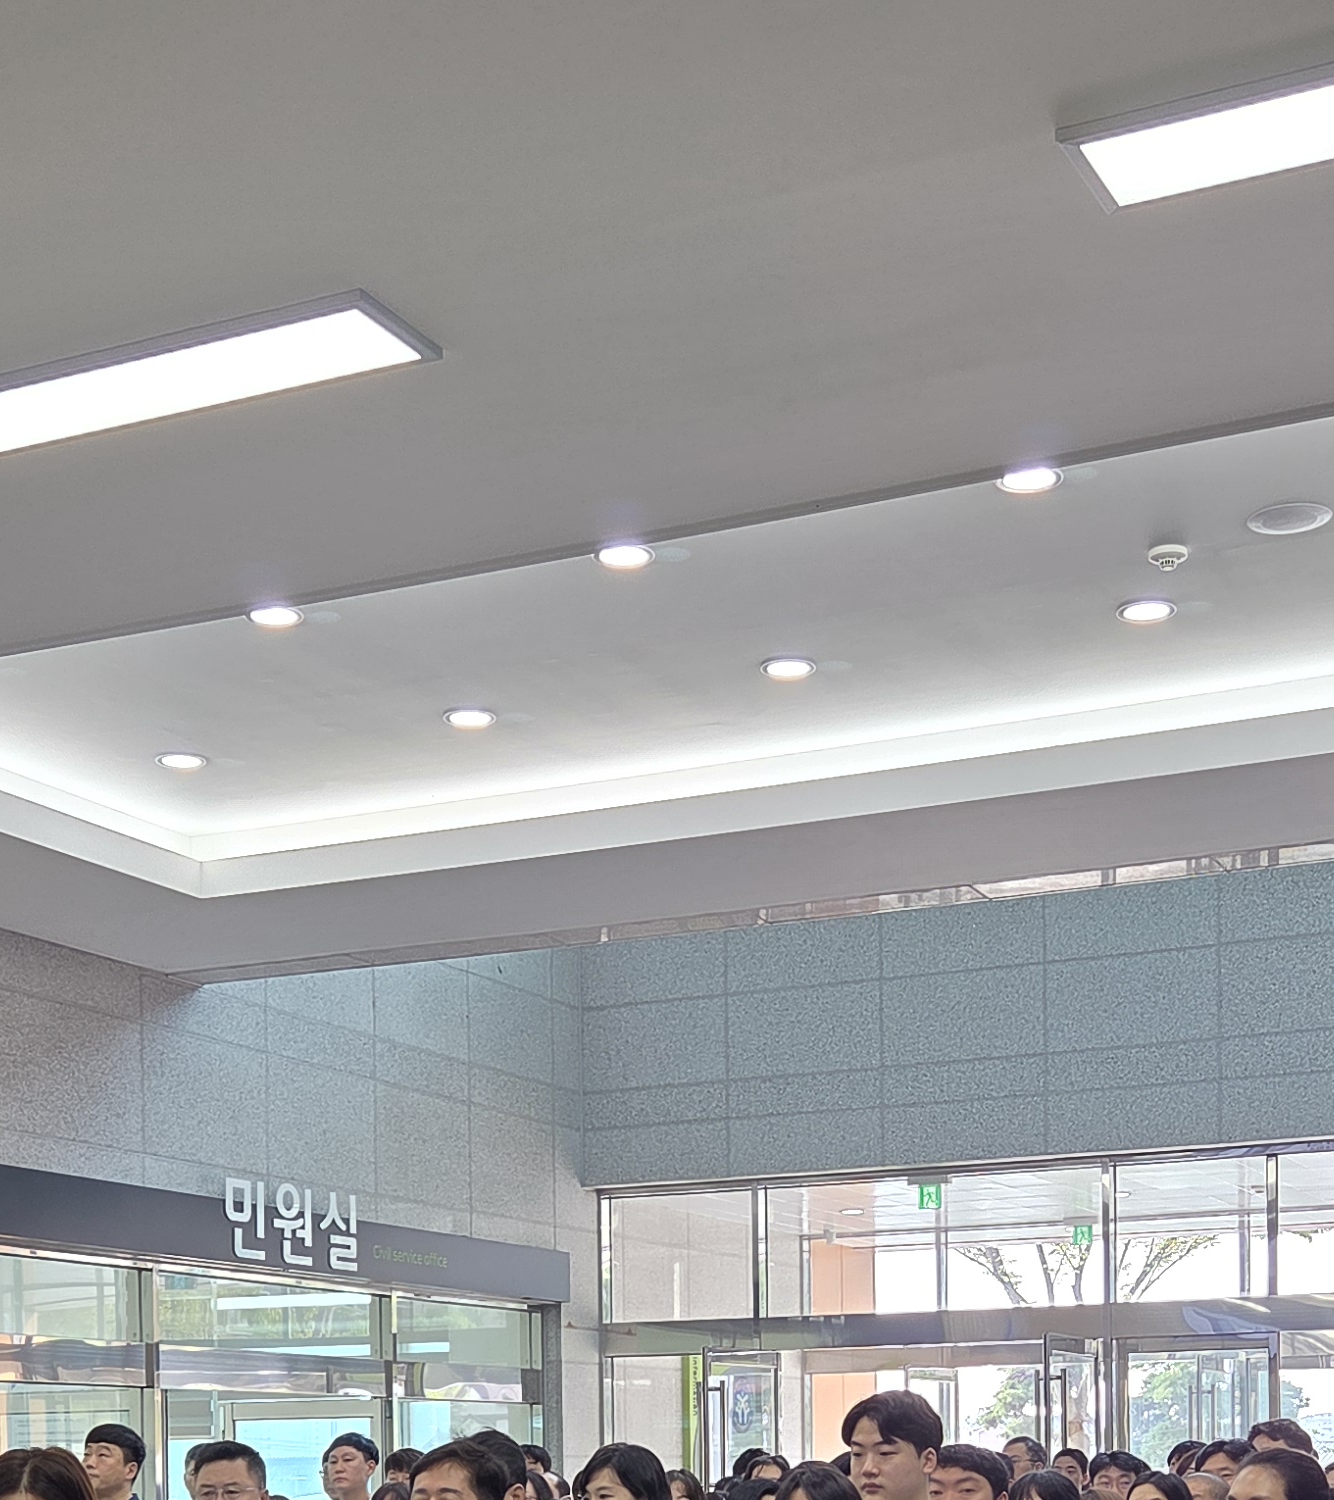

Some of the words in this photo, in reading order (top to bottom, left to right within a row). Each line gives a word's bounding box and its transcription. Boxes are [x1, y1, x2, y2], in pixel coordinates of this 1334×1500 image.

[225, 1177, 358, 1272] 민원실
[373, 1244, 391, 1261] Civil
[393, 1250, 423, 1266] service
[424, 1252, 448, 1268] office
